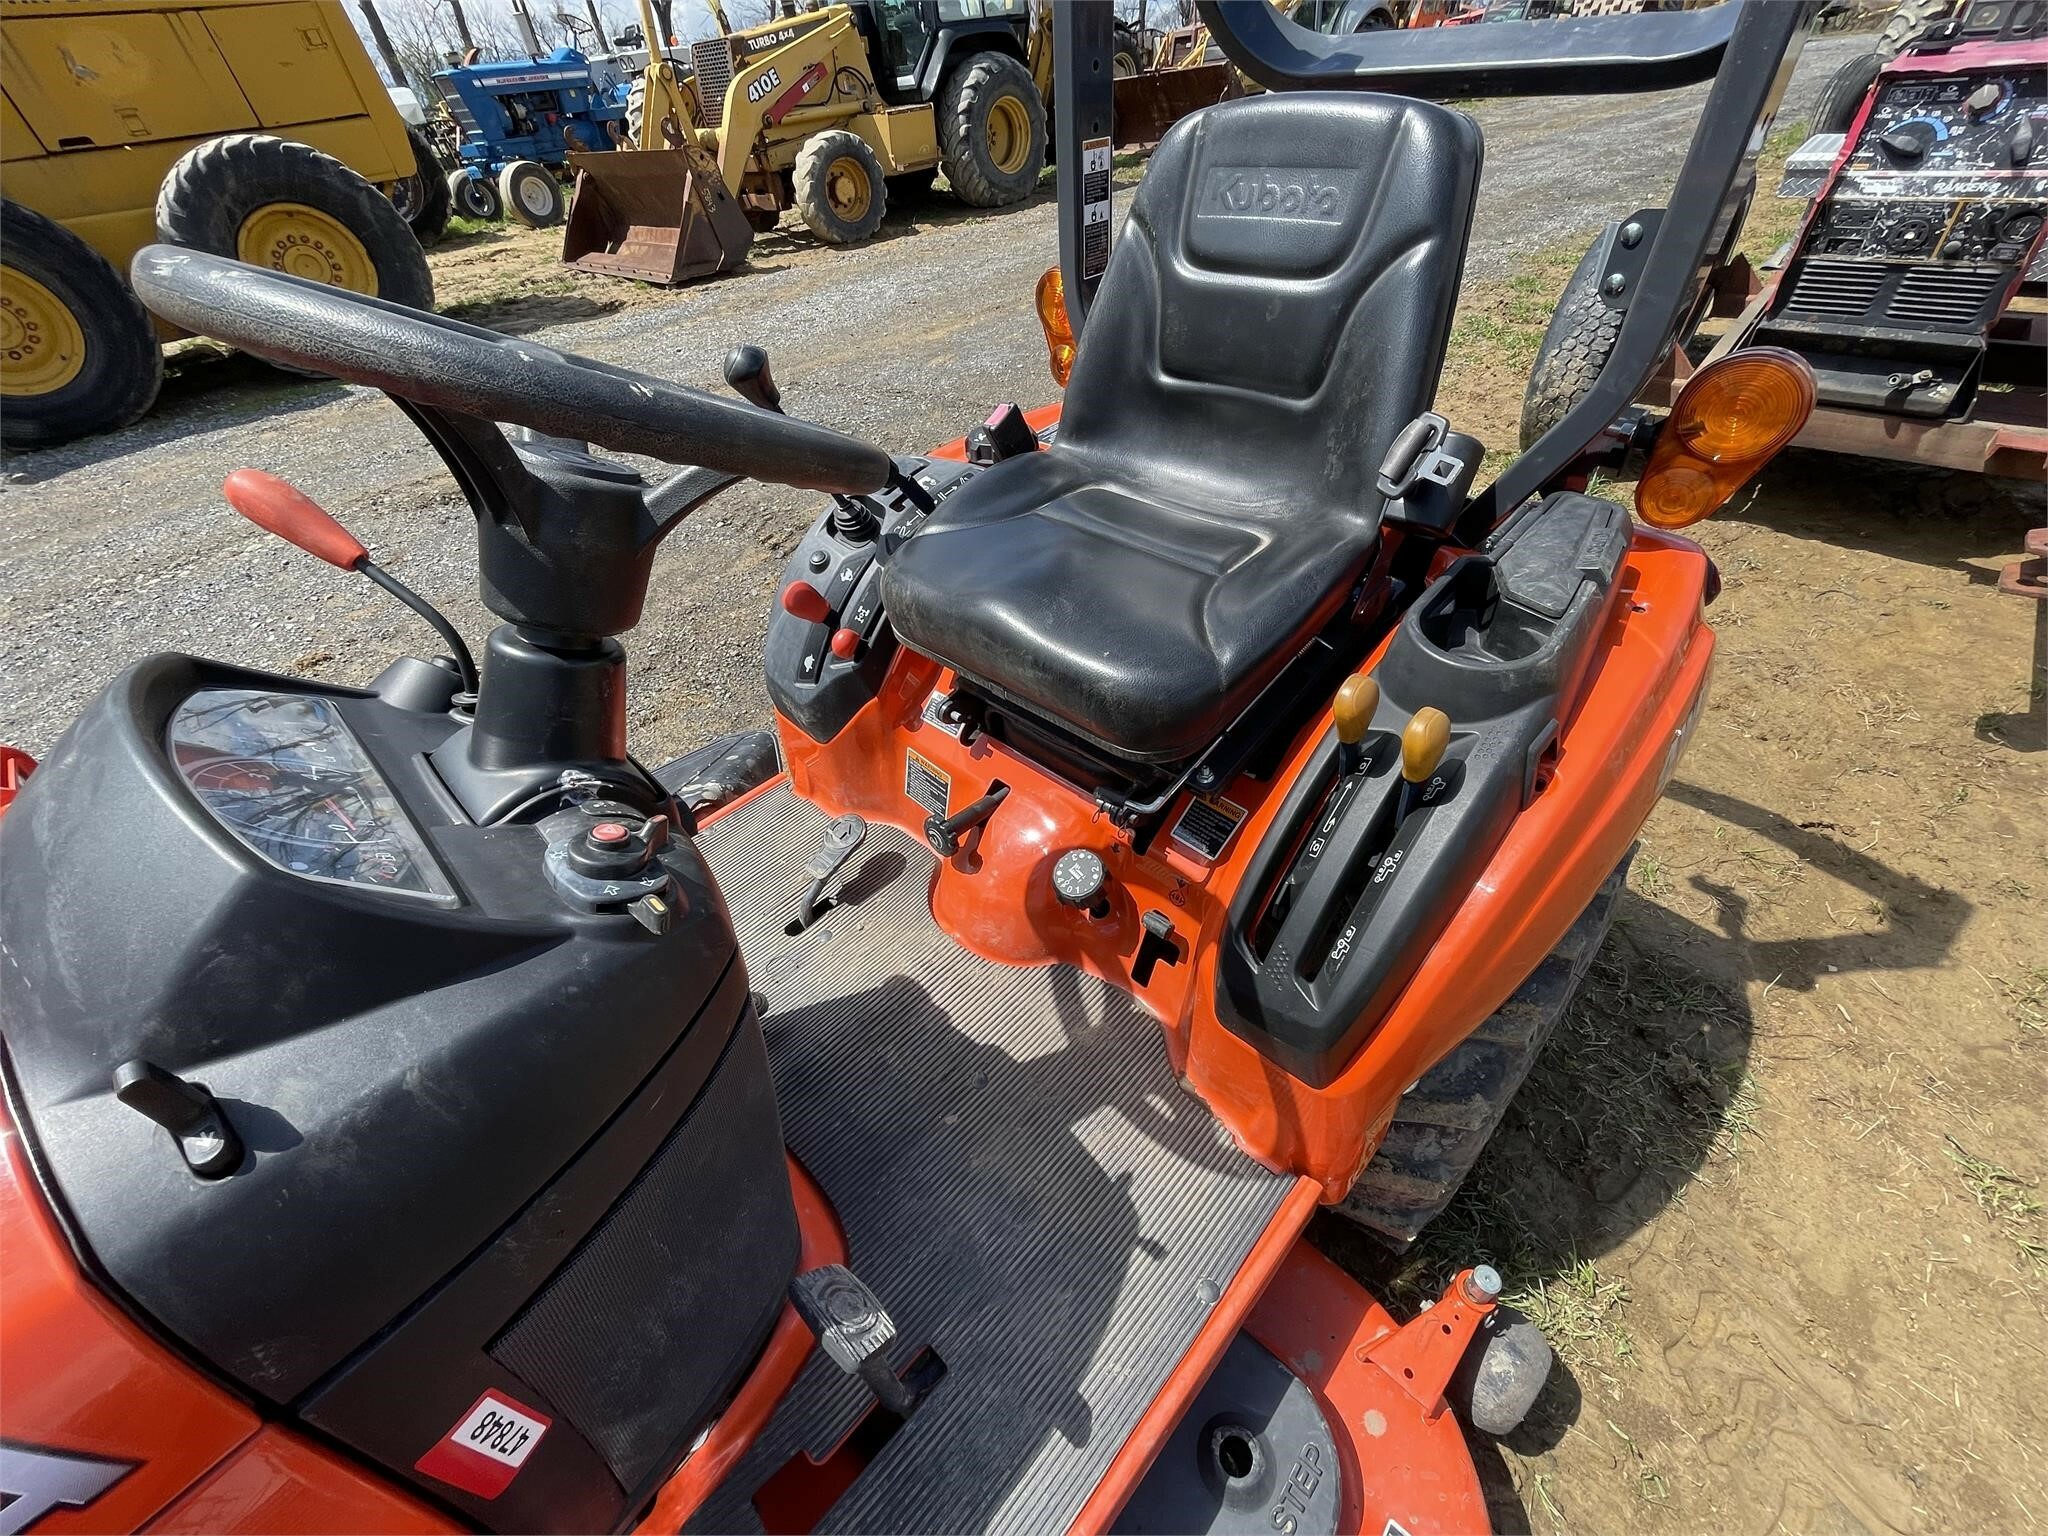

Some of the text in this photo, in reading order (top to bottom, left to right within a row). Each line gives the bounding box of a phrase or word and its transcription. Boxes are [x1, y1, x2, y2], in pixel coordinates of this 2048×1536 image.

[748, 28, 795, 50] TURBO 4x4
[748, 66, 781, 103] 410E
[1219, 172, 1341, 215] Kubota
[470, 1411, 529, 1456] 47848
[1270, 1441, 1323, 1536] STEP
